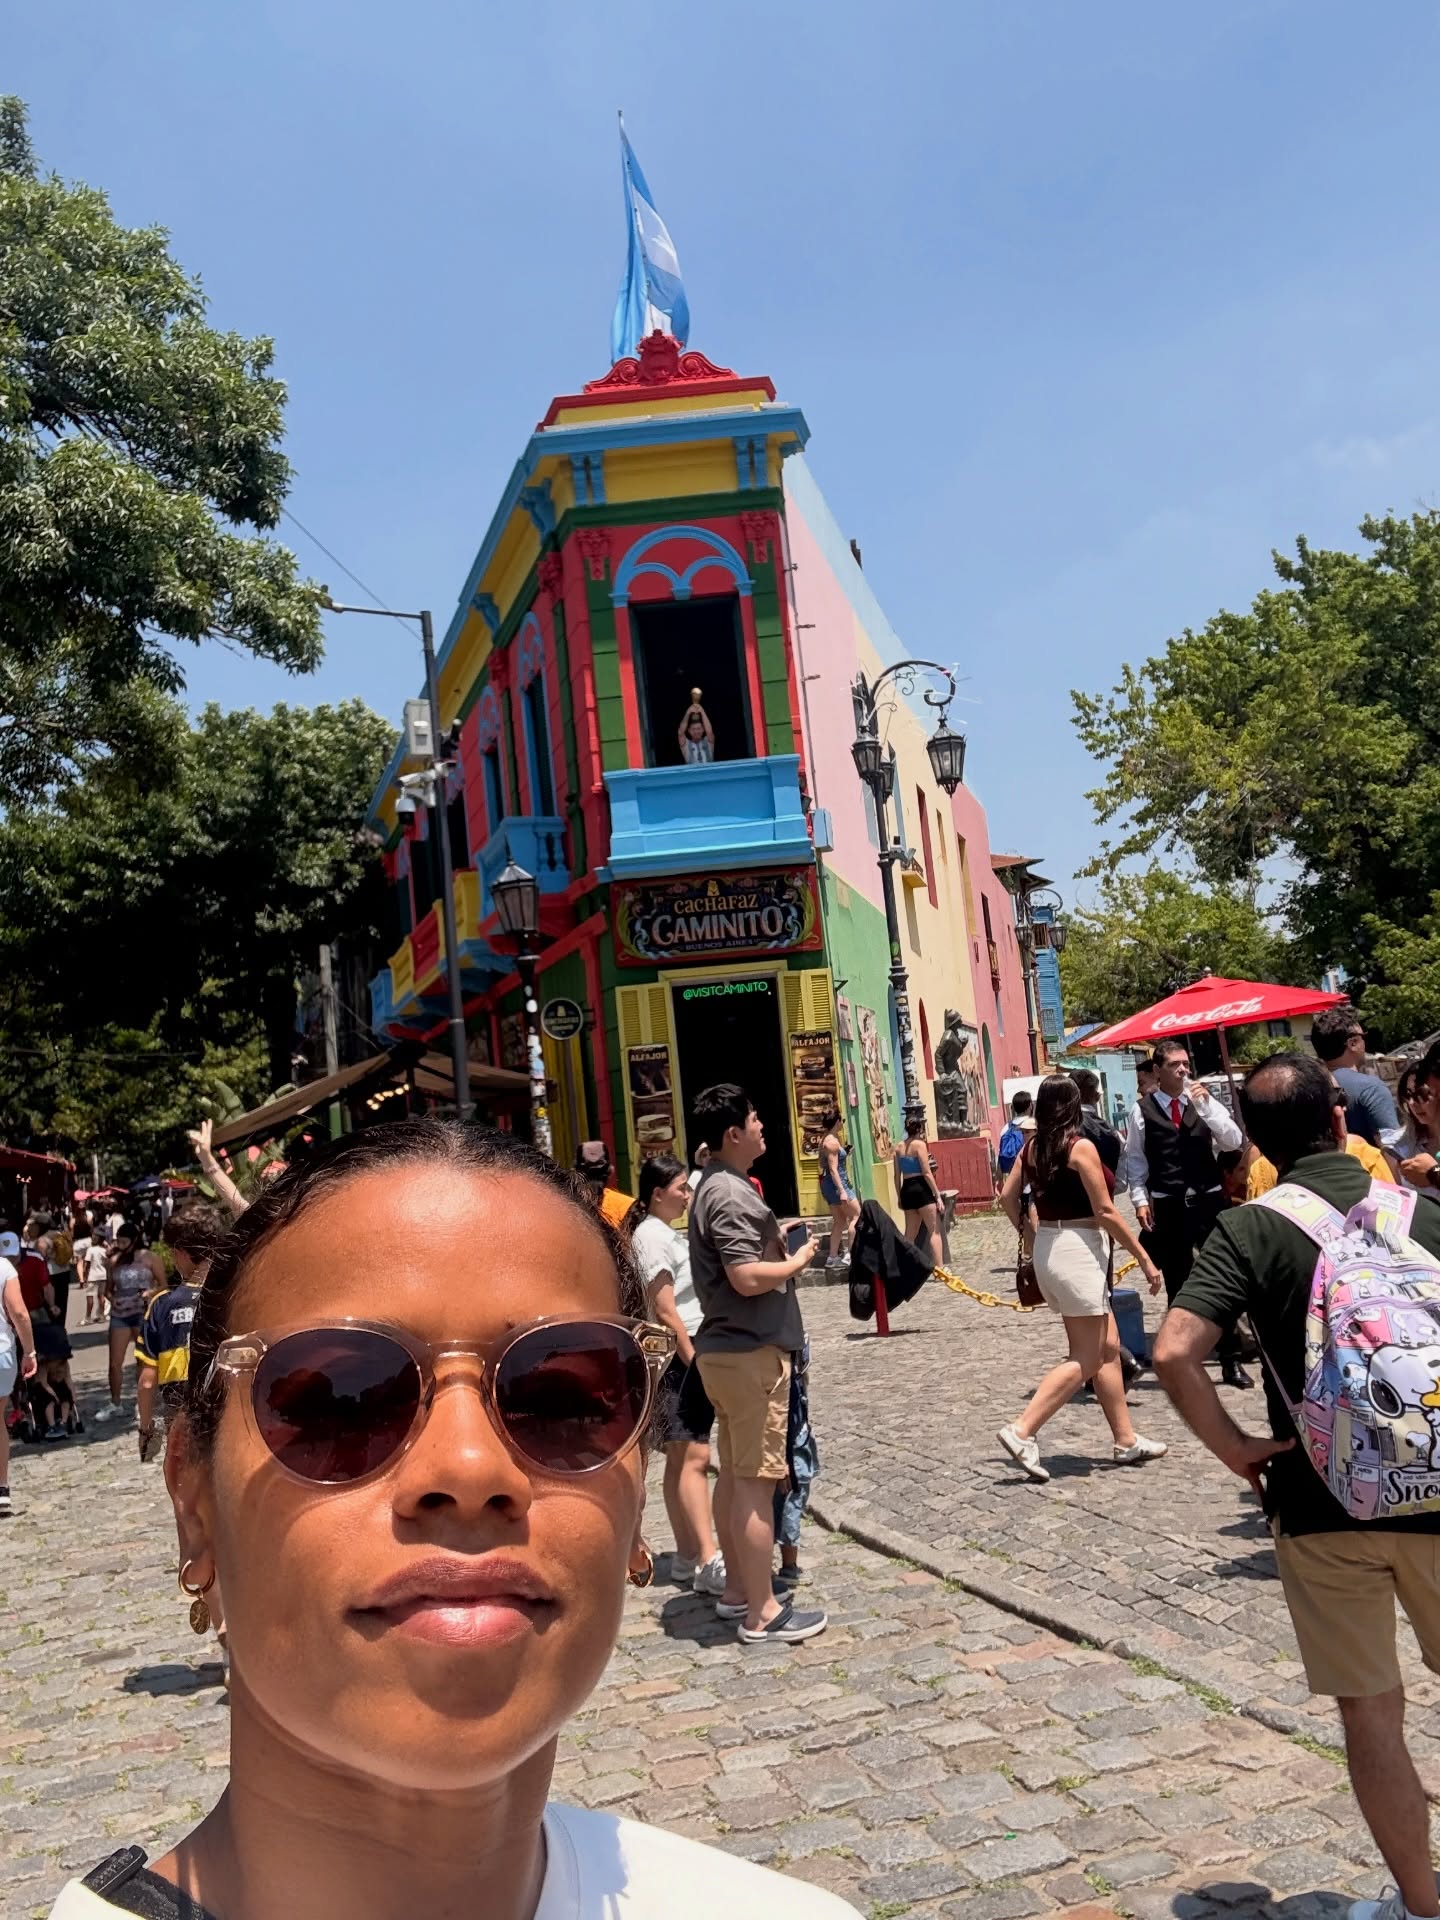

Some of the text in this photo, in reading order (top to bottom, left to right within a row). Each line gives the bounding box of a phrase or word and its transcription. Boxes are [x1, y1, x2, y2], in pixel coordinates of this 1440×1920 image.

[652, 906, 783, 945] CAMINITO
[683, 981, 769, 1000] @VISITCAMINITO
[1151, 996, 1265, 1030] Coca-Cola
[792, 1037, 830, 1047] ALFAJOR
[1384, 1470, 1440, 1505] Sno
